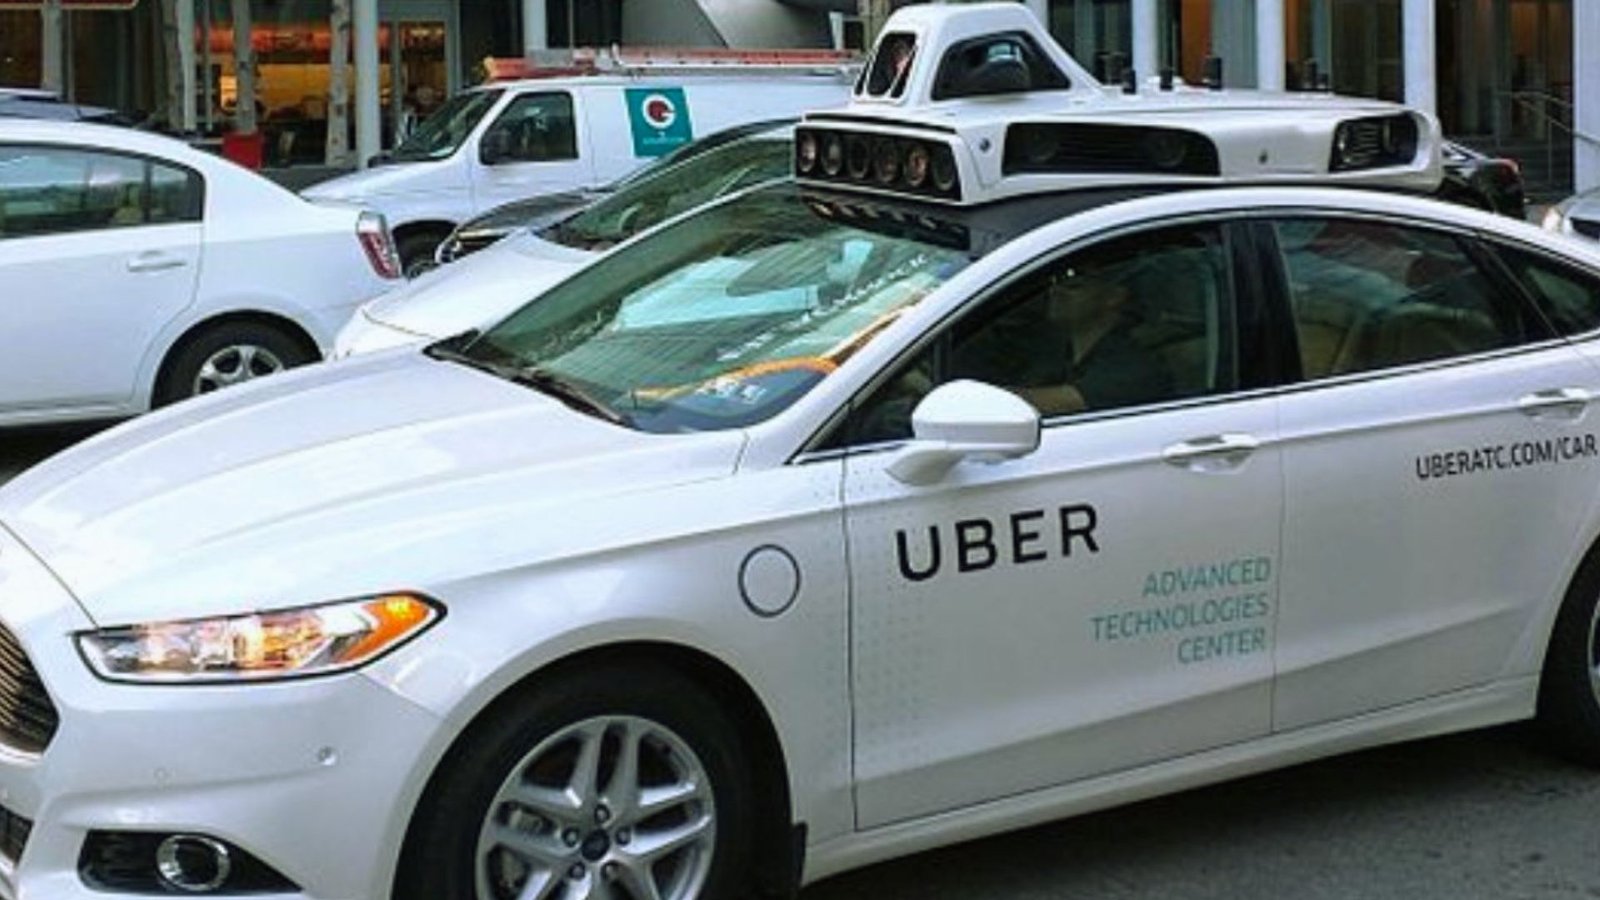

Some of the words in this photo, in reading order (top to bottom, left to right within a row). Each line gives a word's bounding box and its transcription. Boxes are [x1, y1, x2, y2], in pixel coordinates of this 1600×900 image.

[1416, 434, 1598, 480] UBERATC.COM/CAR
[896, 503, 1099, 582] UBER
[1143, 557, 1271, 597] ADVANCED
[1090, 592, 1269, 641] TECHNOLOGIES
[1177, 627, 1266, 664] CENTER
